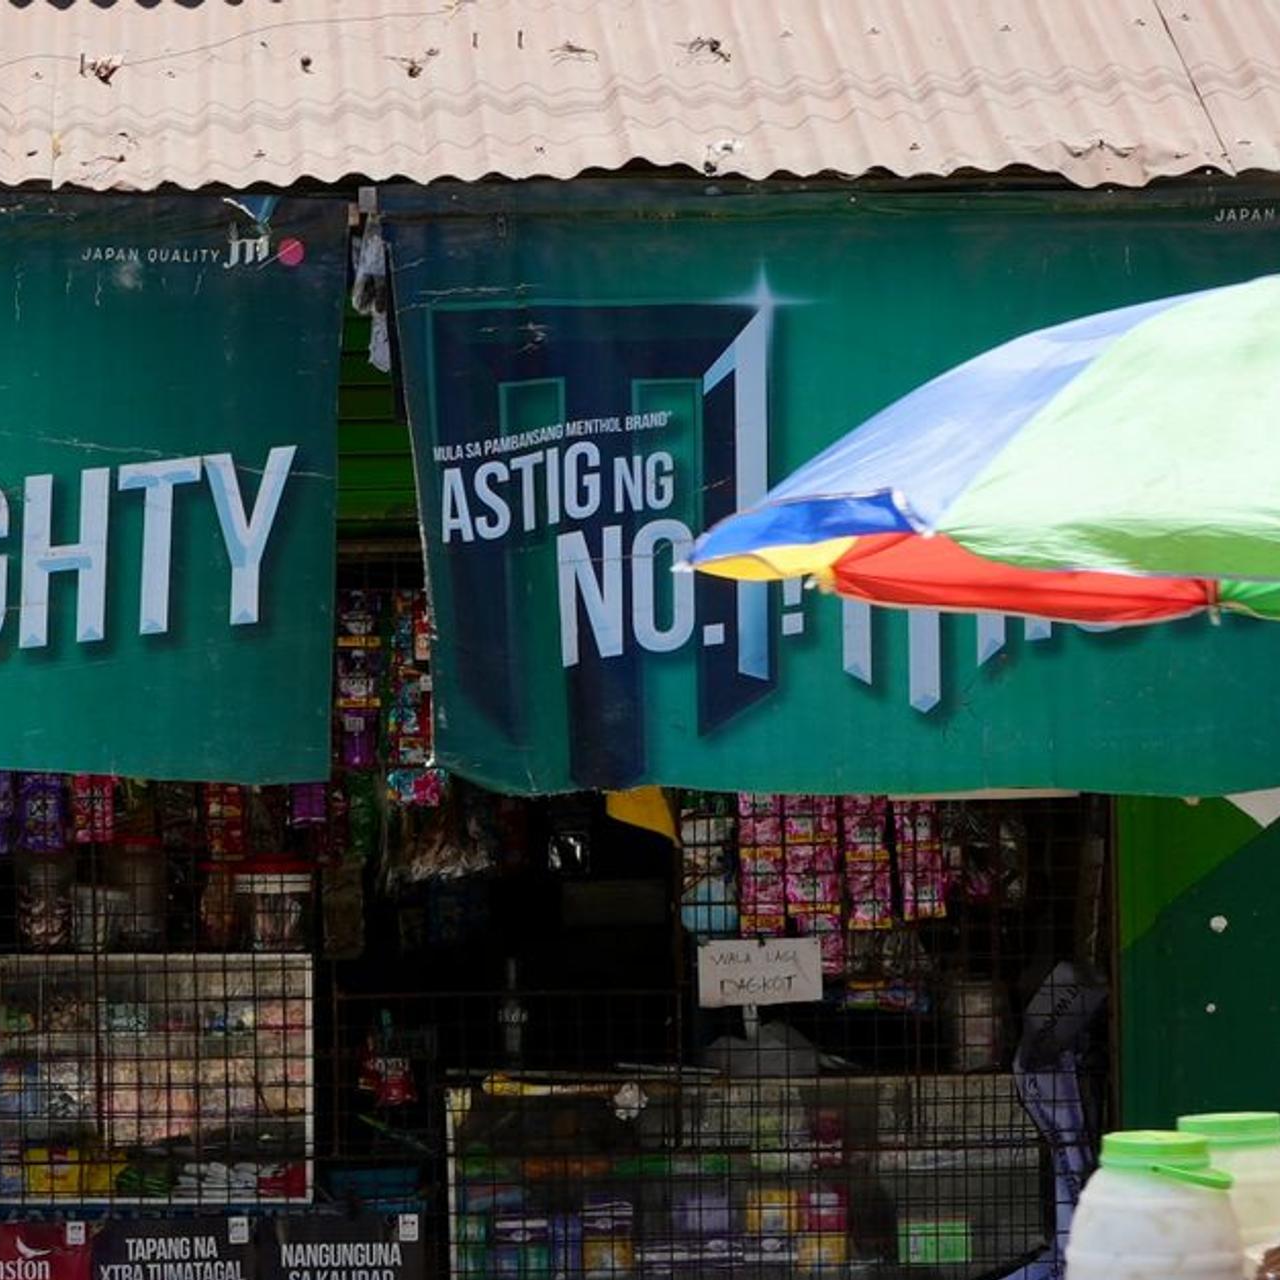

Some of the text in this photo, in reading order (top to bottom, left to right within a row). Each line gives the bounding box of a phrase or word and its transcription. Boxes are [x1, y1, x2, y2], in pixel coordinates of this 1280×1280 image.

[1214, 207, 1276, 224] JAPAN
[80, 247, 139, 262] JAPAN
[146, 247, 220, 263] QUALITY
[465, 441, 482, 459] SA
[484, 424, 565, 456] PAMBANSANG
[565, 416, 623, 438] MENTHOL
[441, 440, 675, 545] ASTIG NG
[125, 1235, 219, 1262] TAPANG NA
[280, 1242, 403, 1268] NANGUNGUNA
